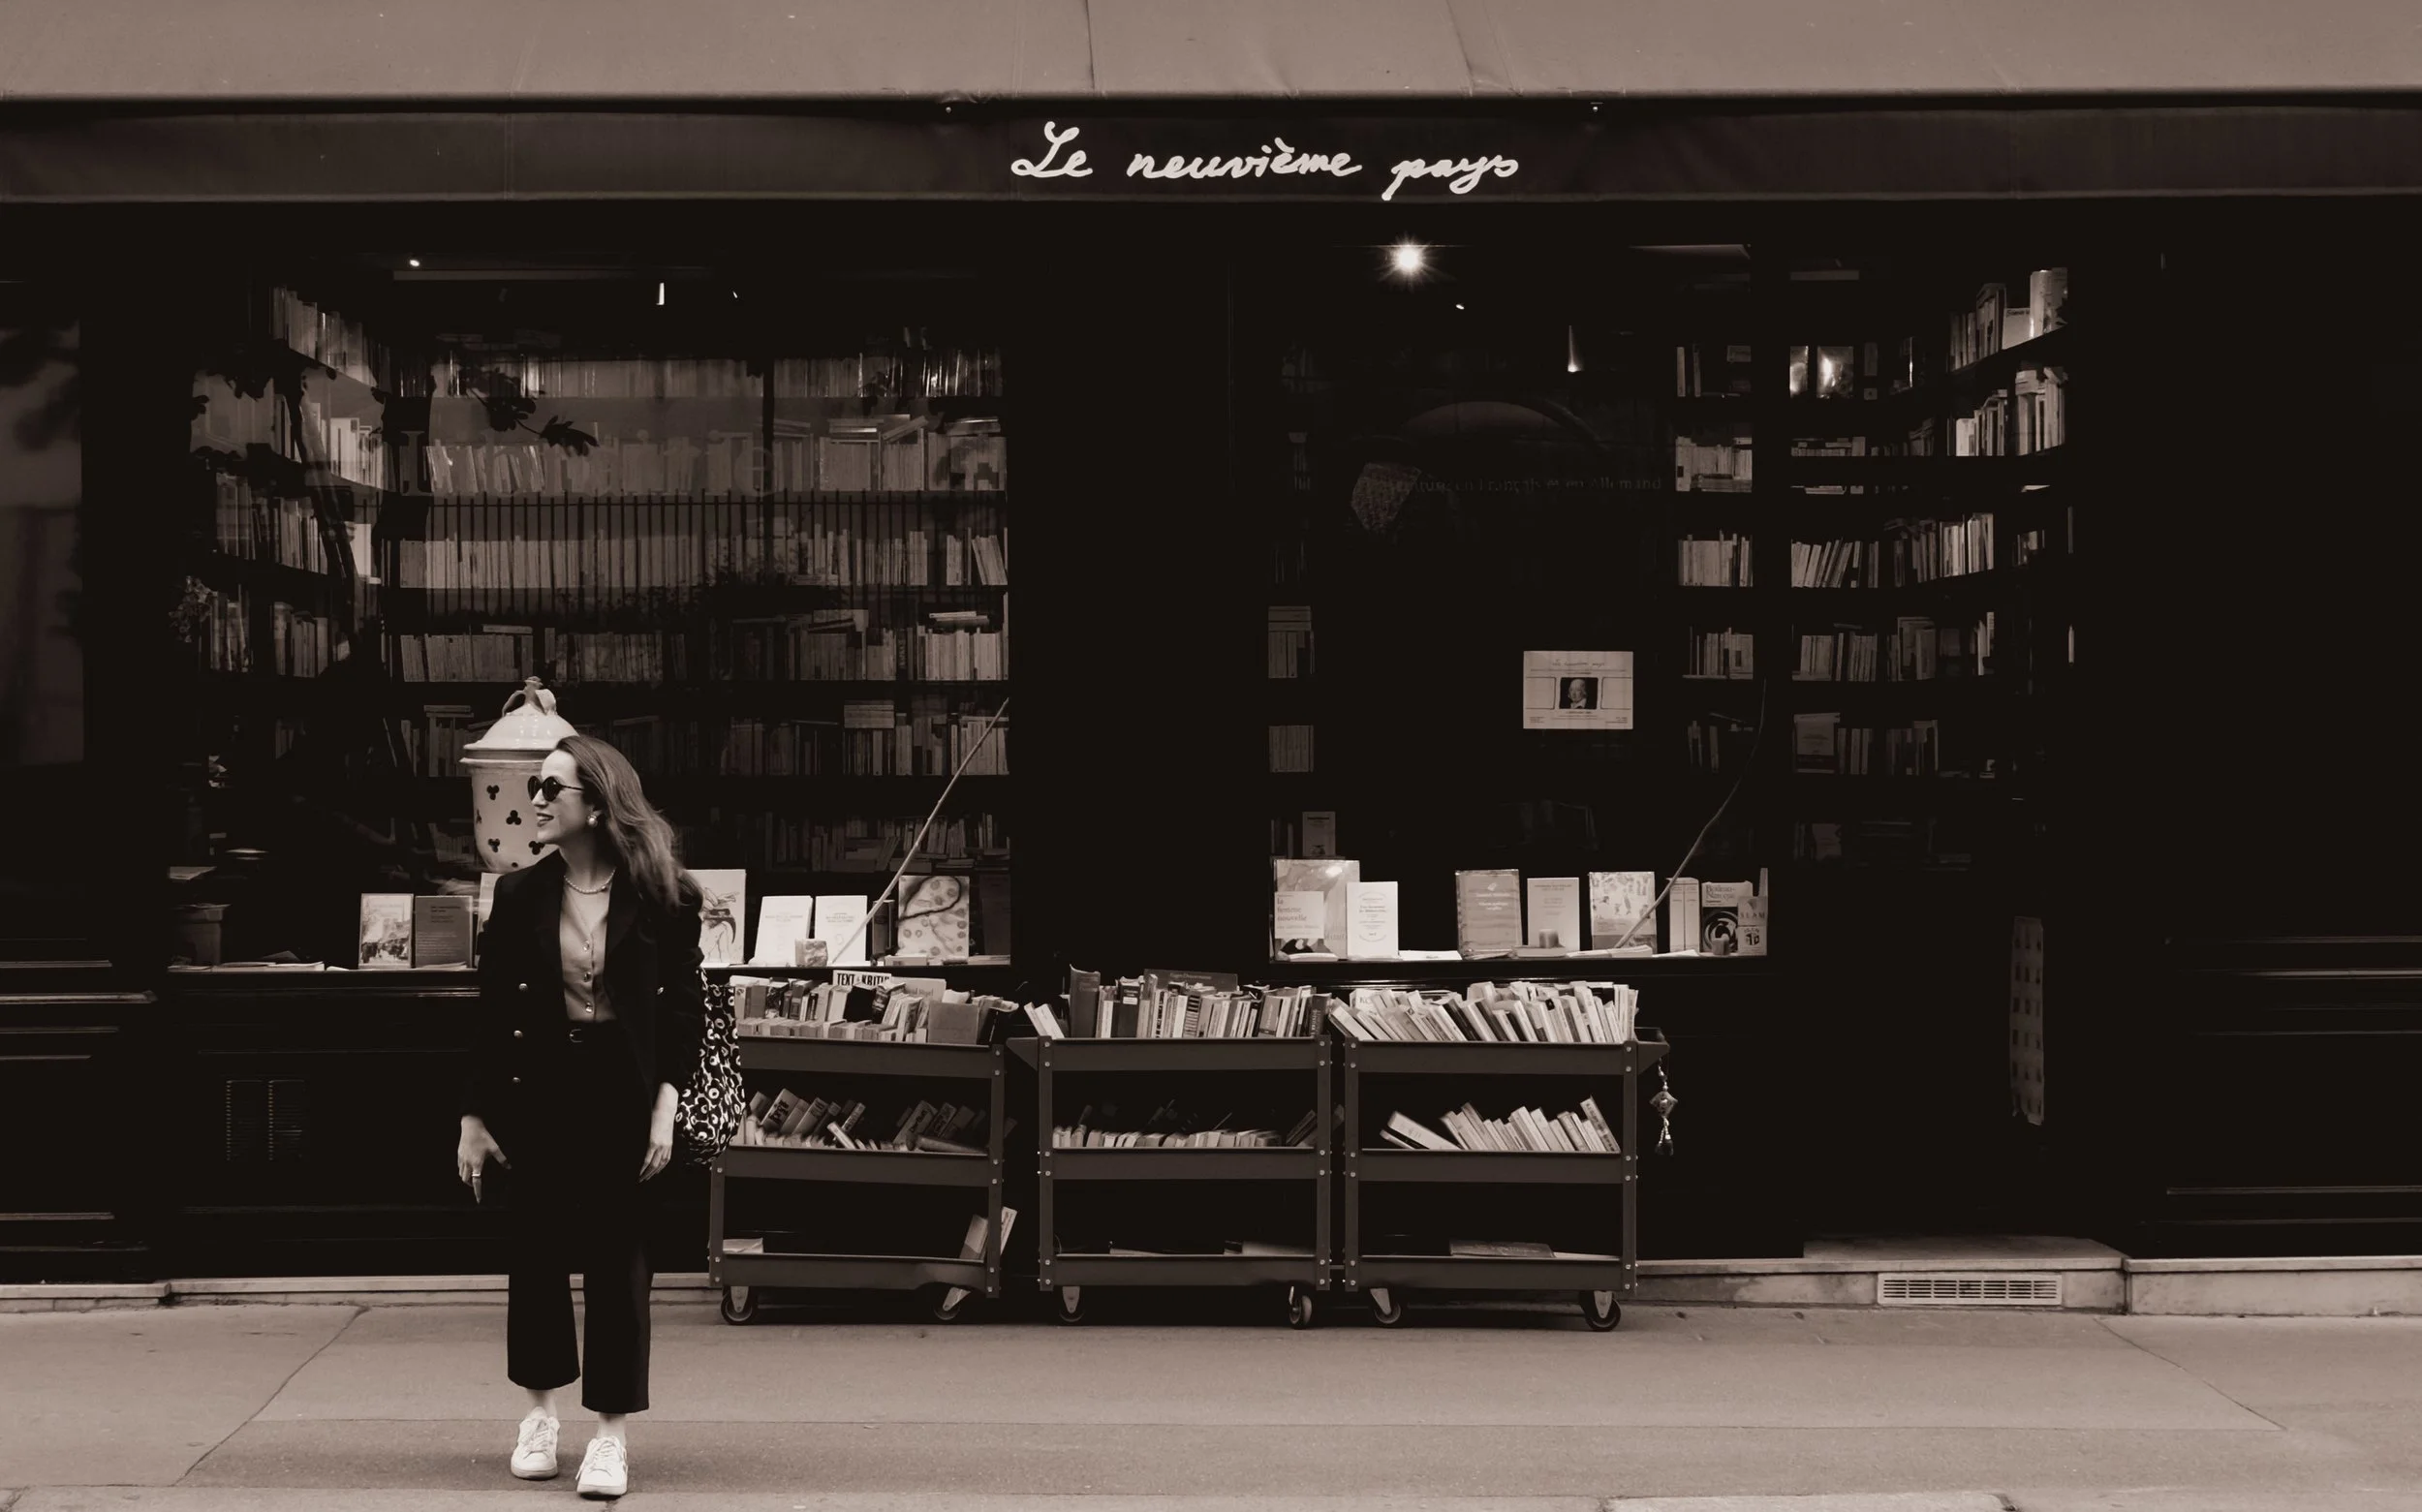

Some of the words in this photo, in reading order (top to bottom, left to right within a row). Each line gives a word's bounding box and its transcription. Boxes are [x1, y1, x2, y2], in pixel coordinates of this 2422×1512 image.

[1010, 121, 1093, 178] Le
[1127, 138, 1362, 179] neuvième
[1381, 152, 1519, 201] pays
[836, 972, 855, 986] TEXT
